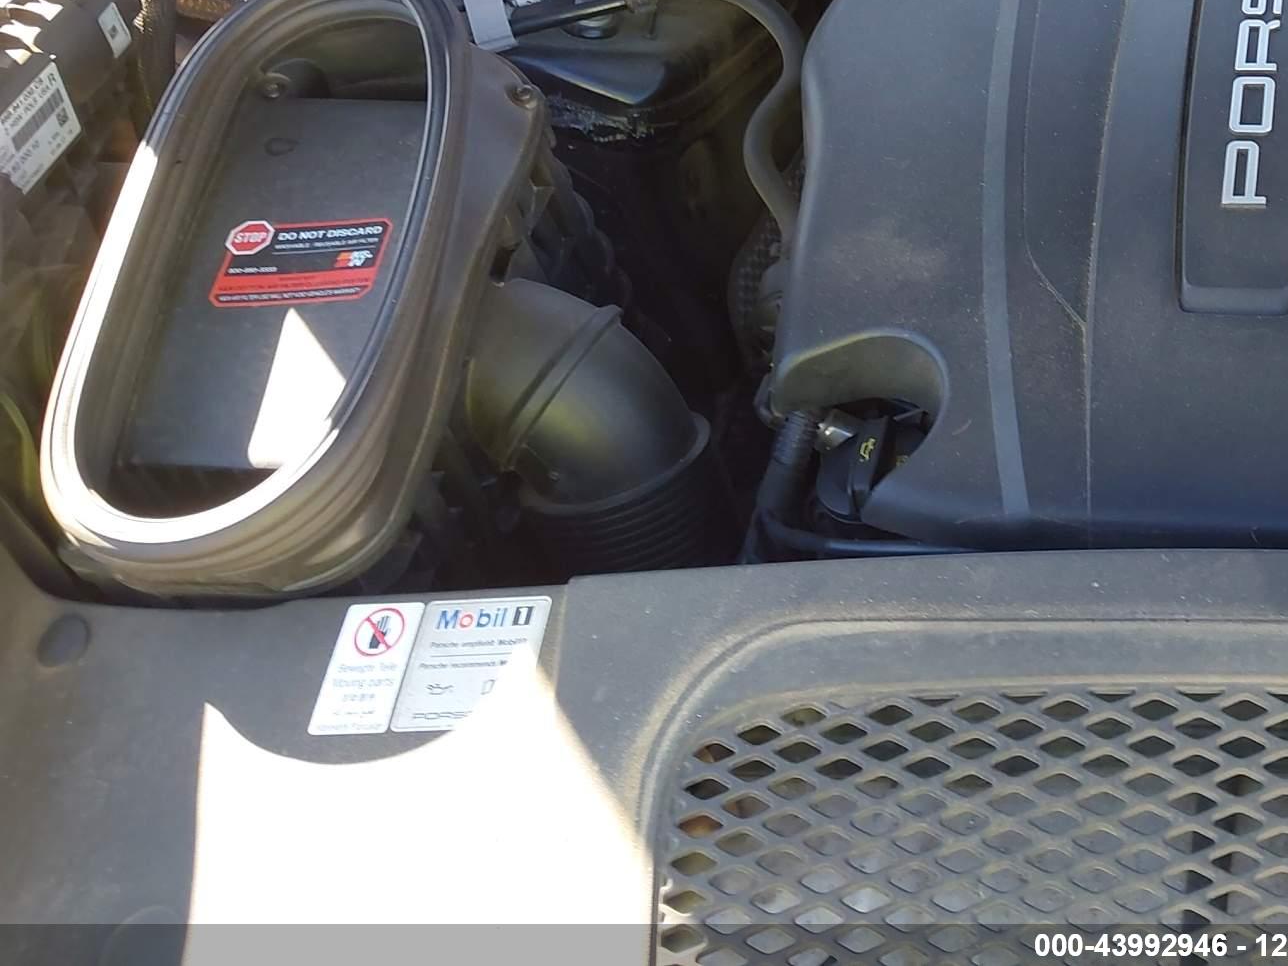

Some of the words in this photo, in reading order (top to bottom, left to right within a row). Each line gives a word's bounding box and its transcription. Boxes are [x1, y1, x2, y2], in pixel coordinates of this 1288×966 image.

[233, 231, 268, 244] STOP
[277, 232, 296, 242] DO
[298, 229, 326, 241] NOT
[326, 225, 384, 239] DISCARD
[435, 607, 509, 630] Mobil
